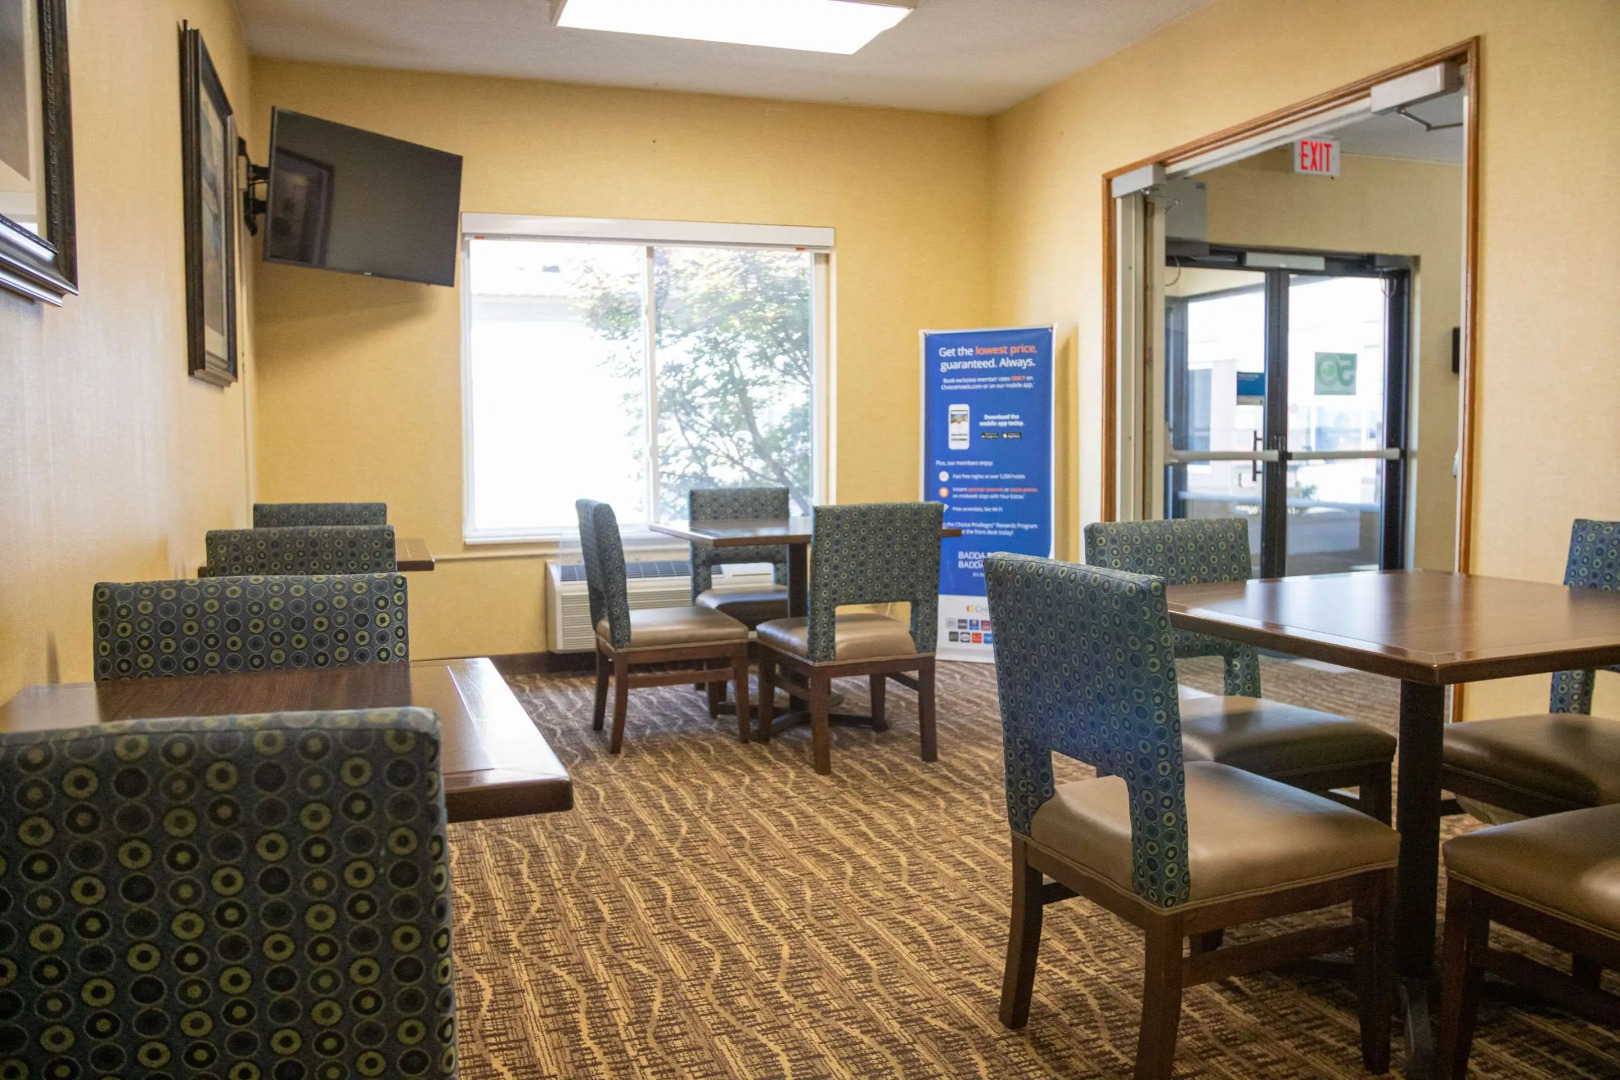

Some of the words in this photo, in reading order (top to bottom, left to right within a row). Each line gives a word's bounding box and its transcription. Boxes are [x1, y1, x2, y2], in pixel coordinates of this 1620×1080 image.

[1301, 140, 1332, 172] EXIT
[938, 347, 956, 357] Get
[957, 346, 974, 356] the
[975, 345, 1008, 355] lowest
[940, 358, 997, 373] guaranteed.
[999, 357, 1036, 369] Always.
[1017, 523, 1039, 531] Program
